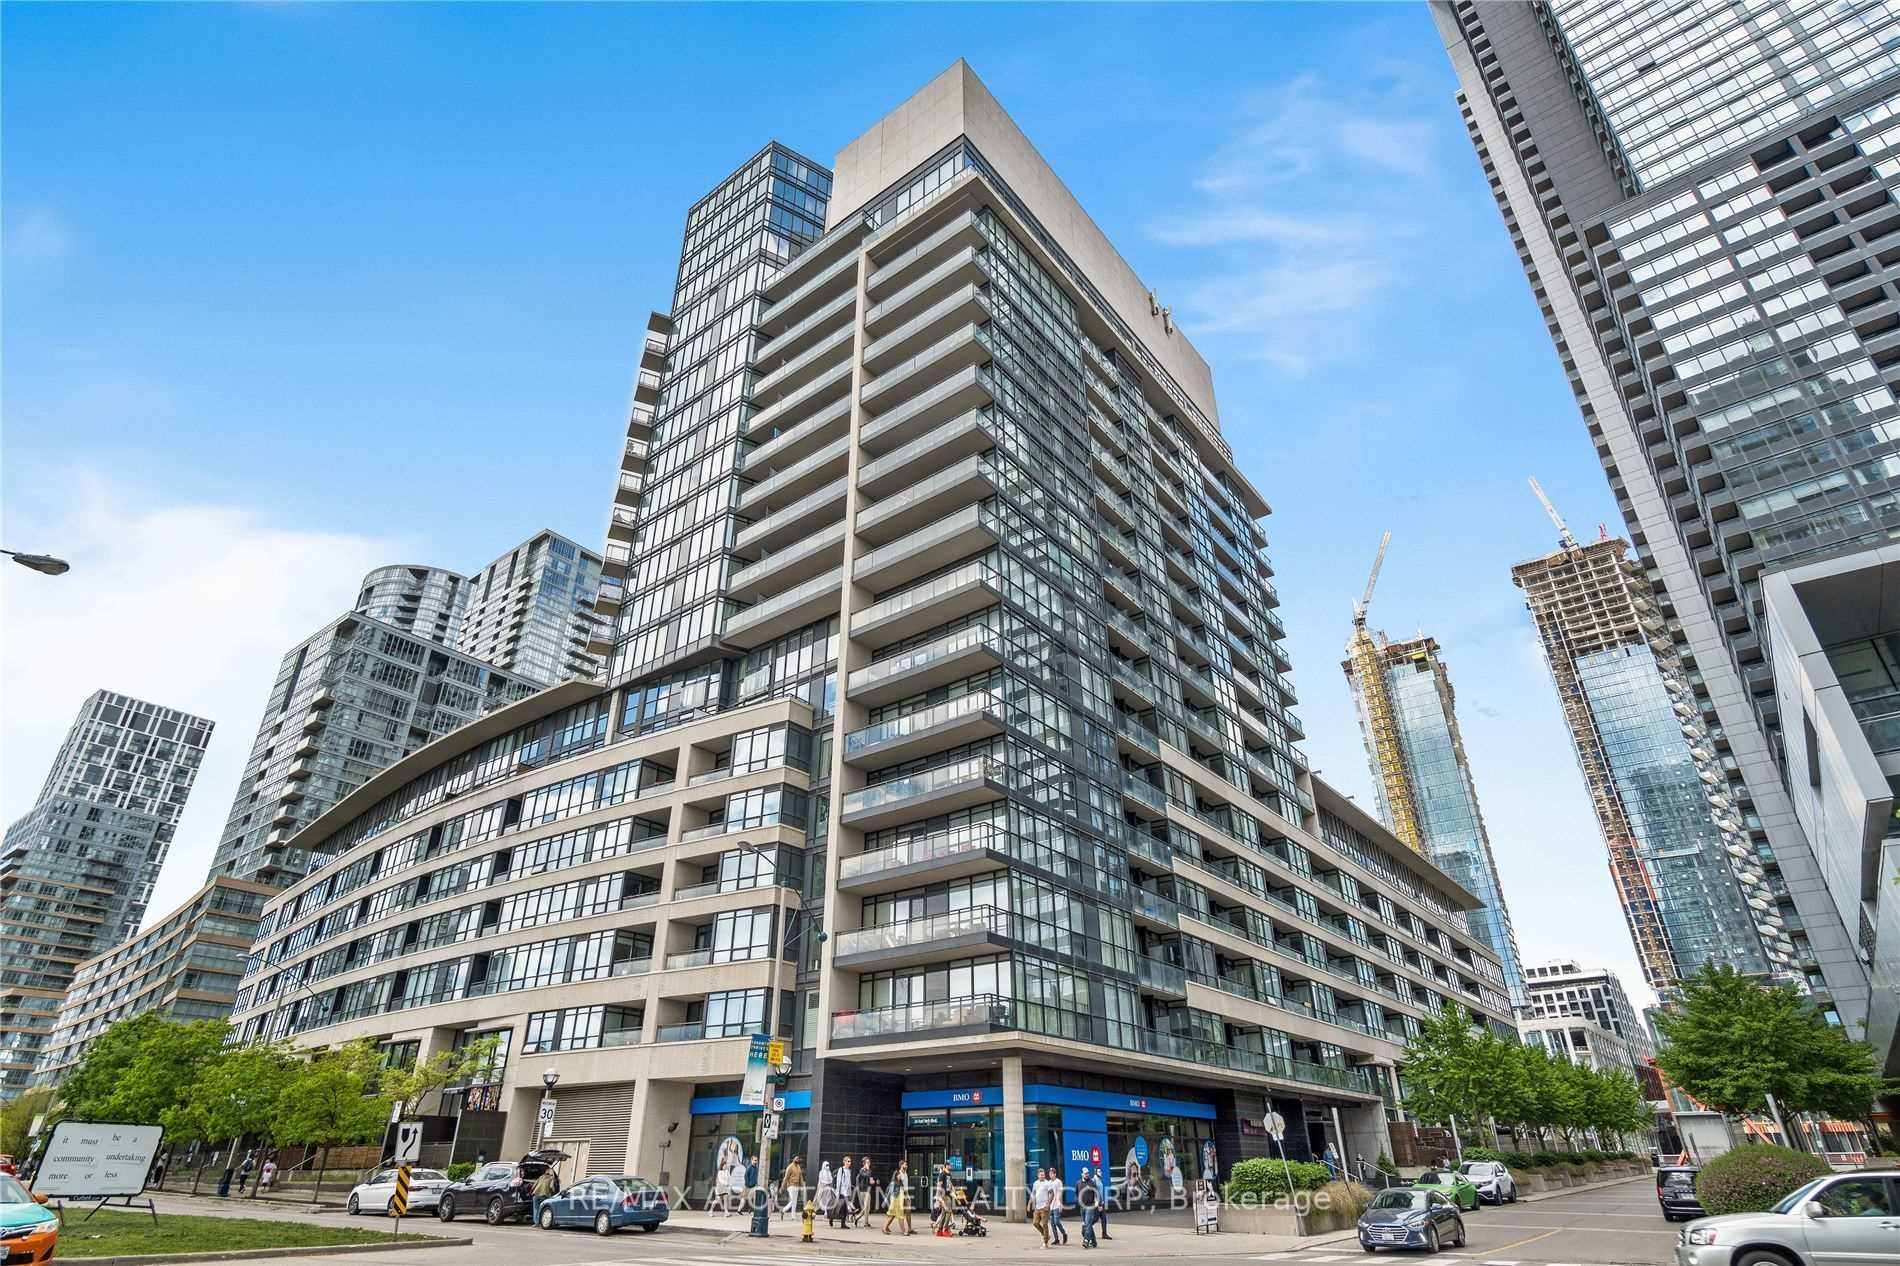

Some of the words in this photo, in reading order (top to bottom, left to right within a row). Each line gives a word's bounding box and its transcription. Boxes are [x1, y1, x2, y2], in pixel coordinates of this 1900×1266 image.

[750, 1051, 768, 1059] HERE
[953, 1093, 970, 1102] BMO
[1129, 1099, 1140, 1107] BMO
[540, 1108, 553, 1120] 30
[62, 1136, 69, 1144] it
[112, 1133, 121, 1141] be
[53, 1155, 94, 1165] community
[105, 1153, 146, 1163] undertaking
[1071, 1150, 1090, 1161] BMO
[48, 1172, 69, 1180] more
[104, 1170, 118, 1179] less
